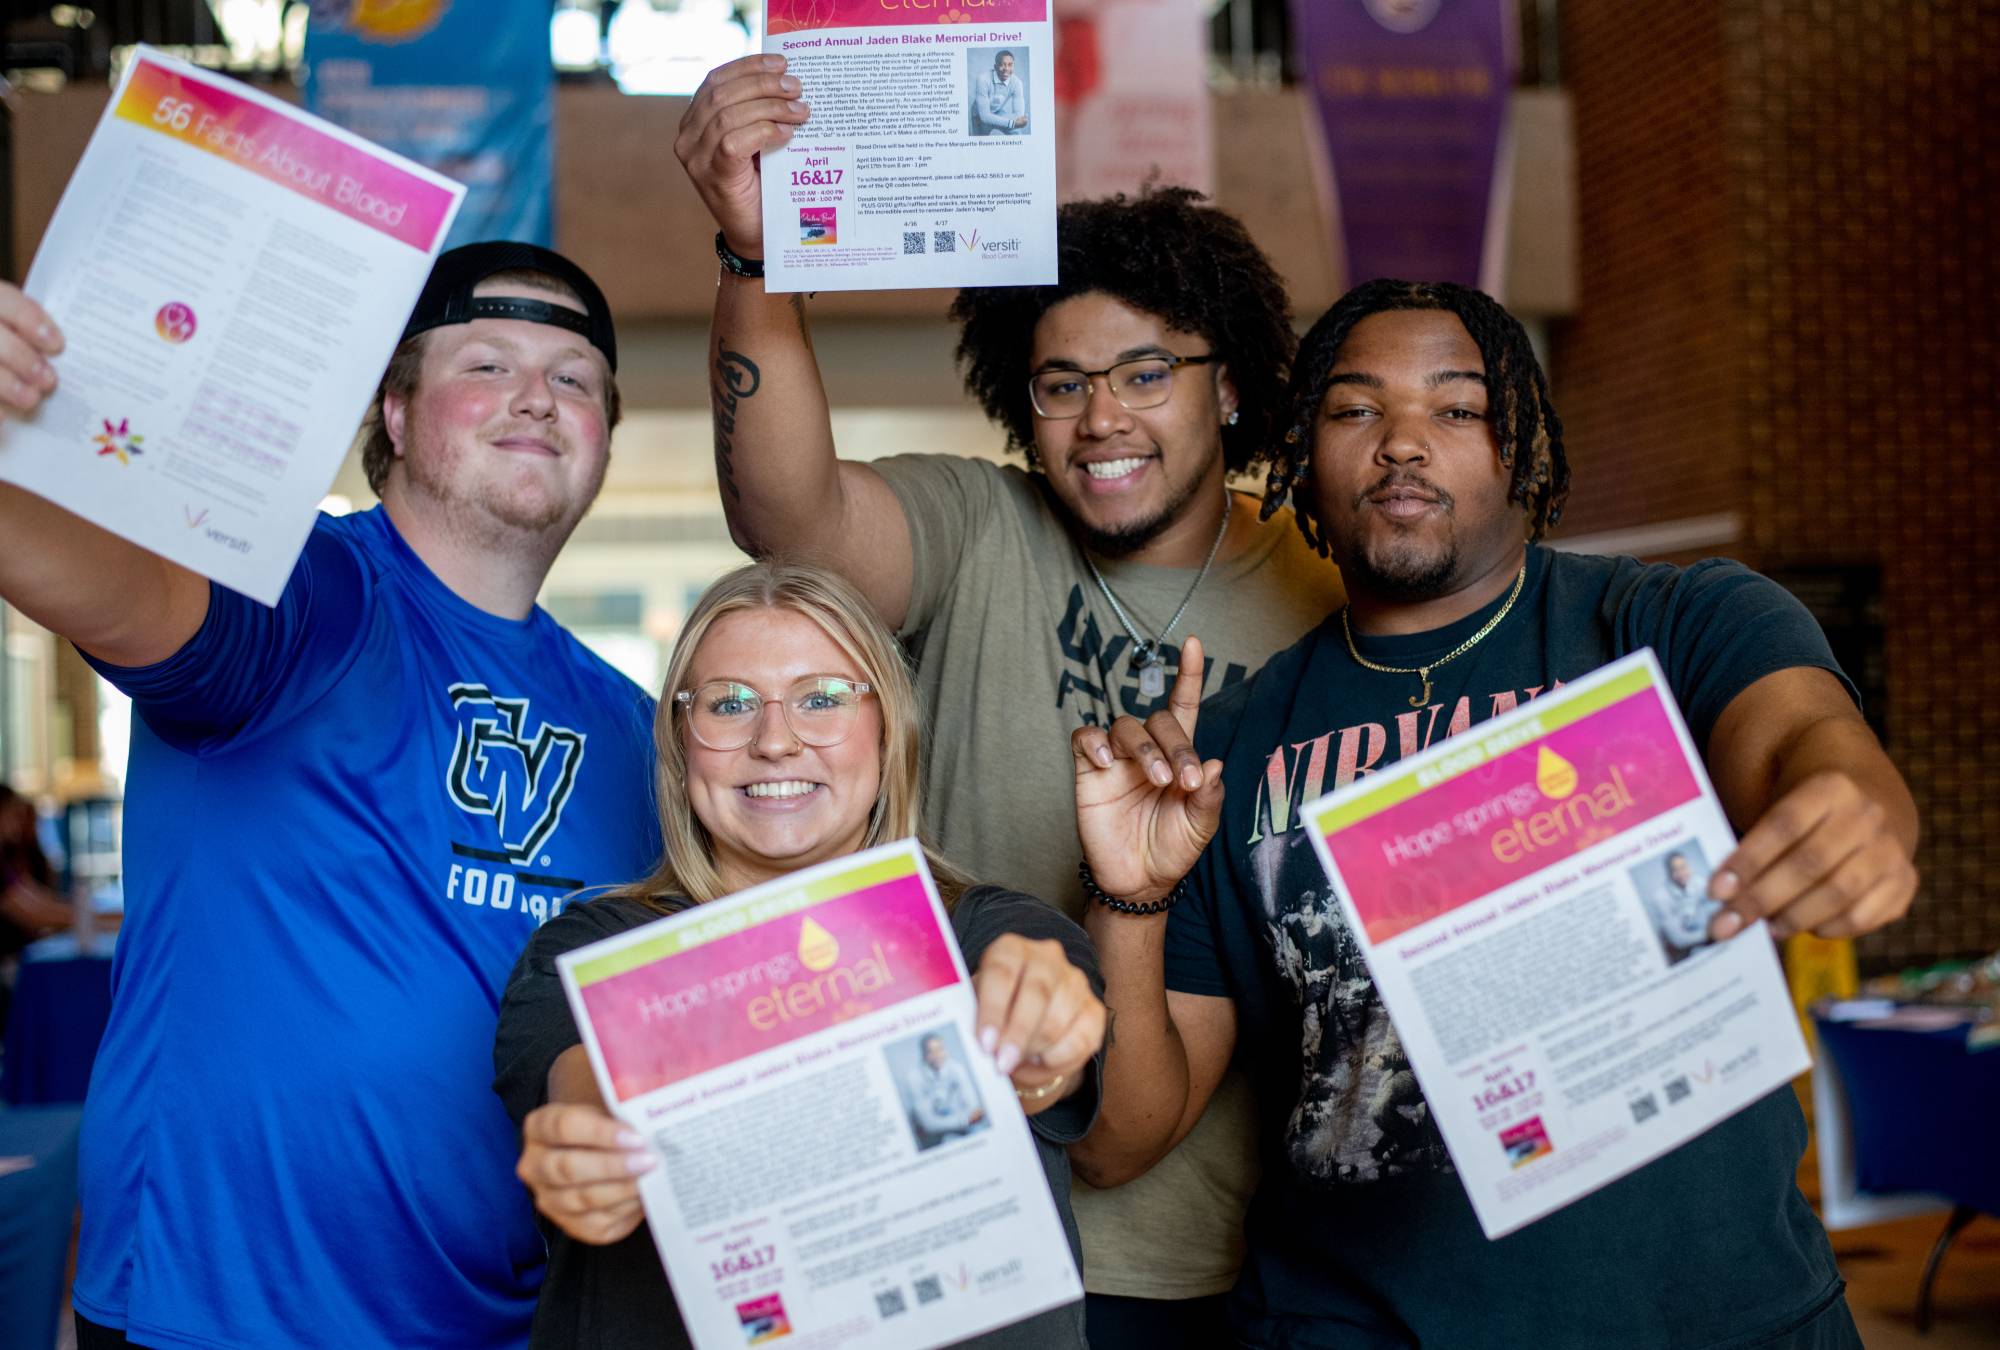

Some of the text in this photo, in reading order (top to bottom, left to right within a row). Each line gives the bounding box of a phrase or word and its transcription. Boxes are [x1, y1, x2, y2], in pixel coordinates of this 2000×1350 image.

[782, 32, 1022, 50] Second Annual Jaden Blake Memorial Drive!
[152, 95, 193, 130] 56
[195, 112, 253, 158] Facts
[260, 141, 332, 194] About
[335, 172, 407, 228] Blood
[791, 170, 843, 186] 16&17
[805, 157, 828, 168] April
[981, 238, 1019, 251] versiti
[1247, 677, 1567, 845] NIRV
[1415, 718, 1544, 788] BLOOD DRIVE
[1380, 780, 1538, 867] Hope springs
[1490, 764, 1636, 864] eternal
[637, 982, 708, 1024] Hope
[710, 948, 799, 1001] springs
[746, 941, 896, 1031] eternal
[1471, 1073, 1539, 1113] 16&17
[710, 1246, 779, 1281] 16&17
